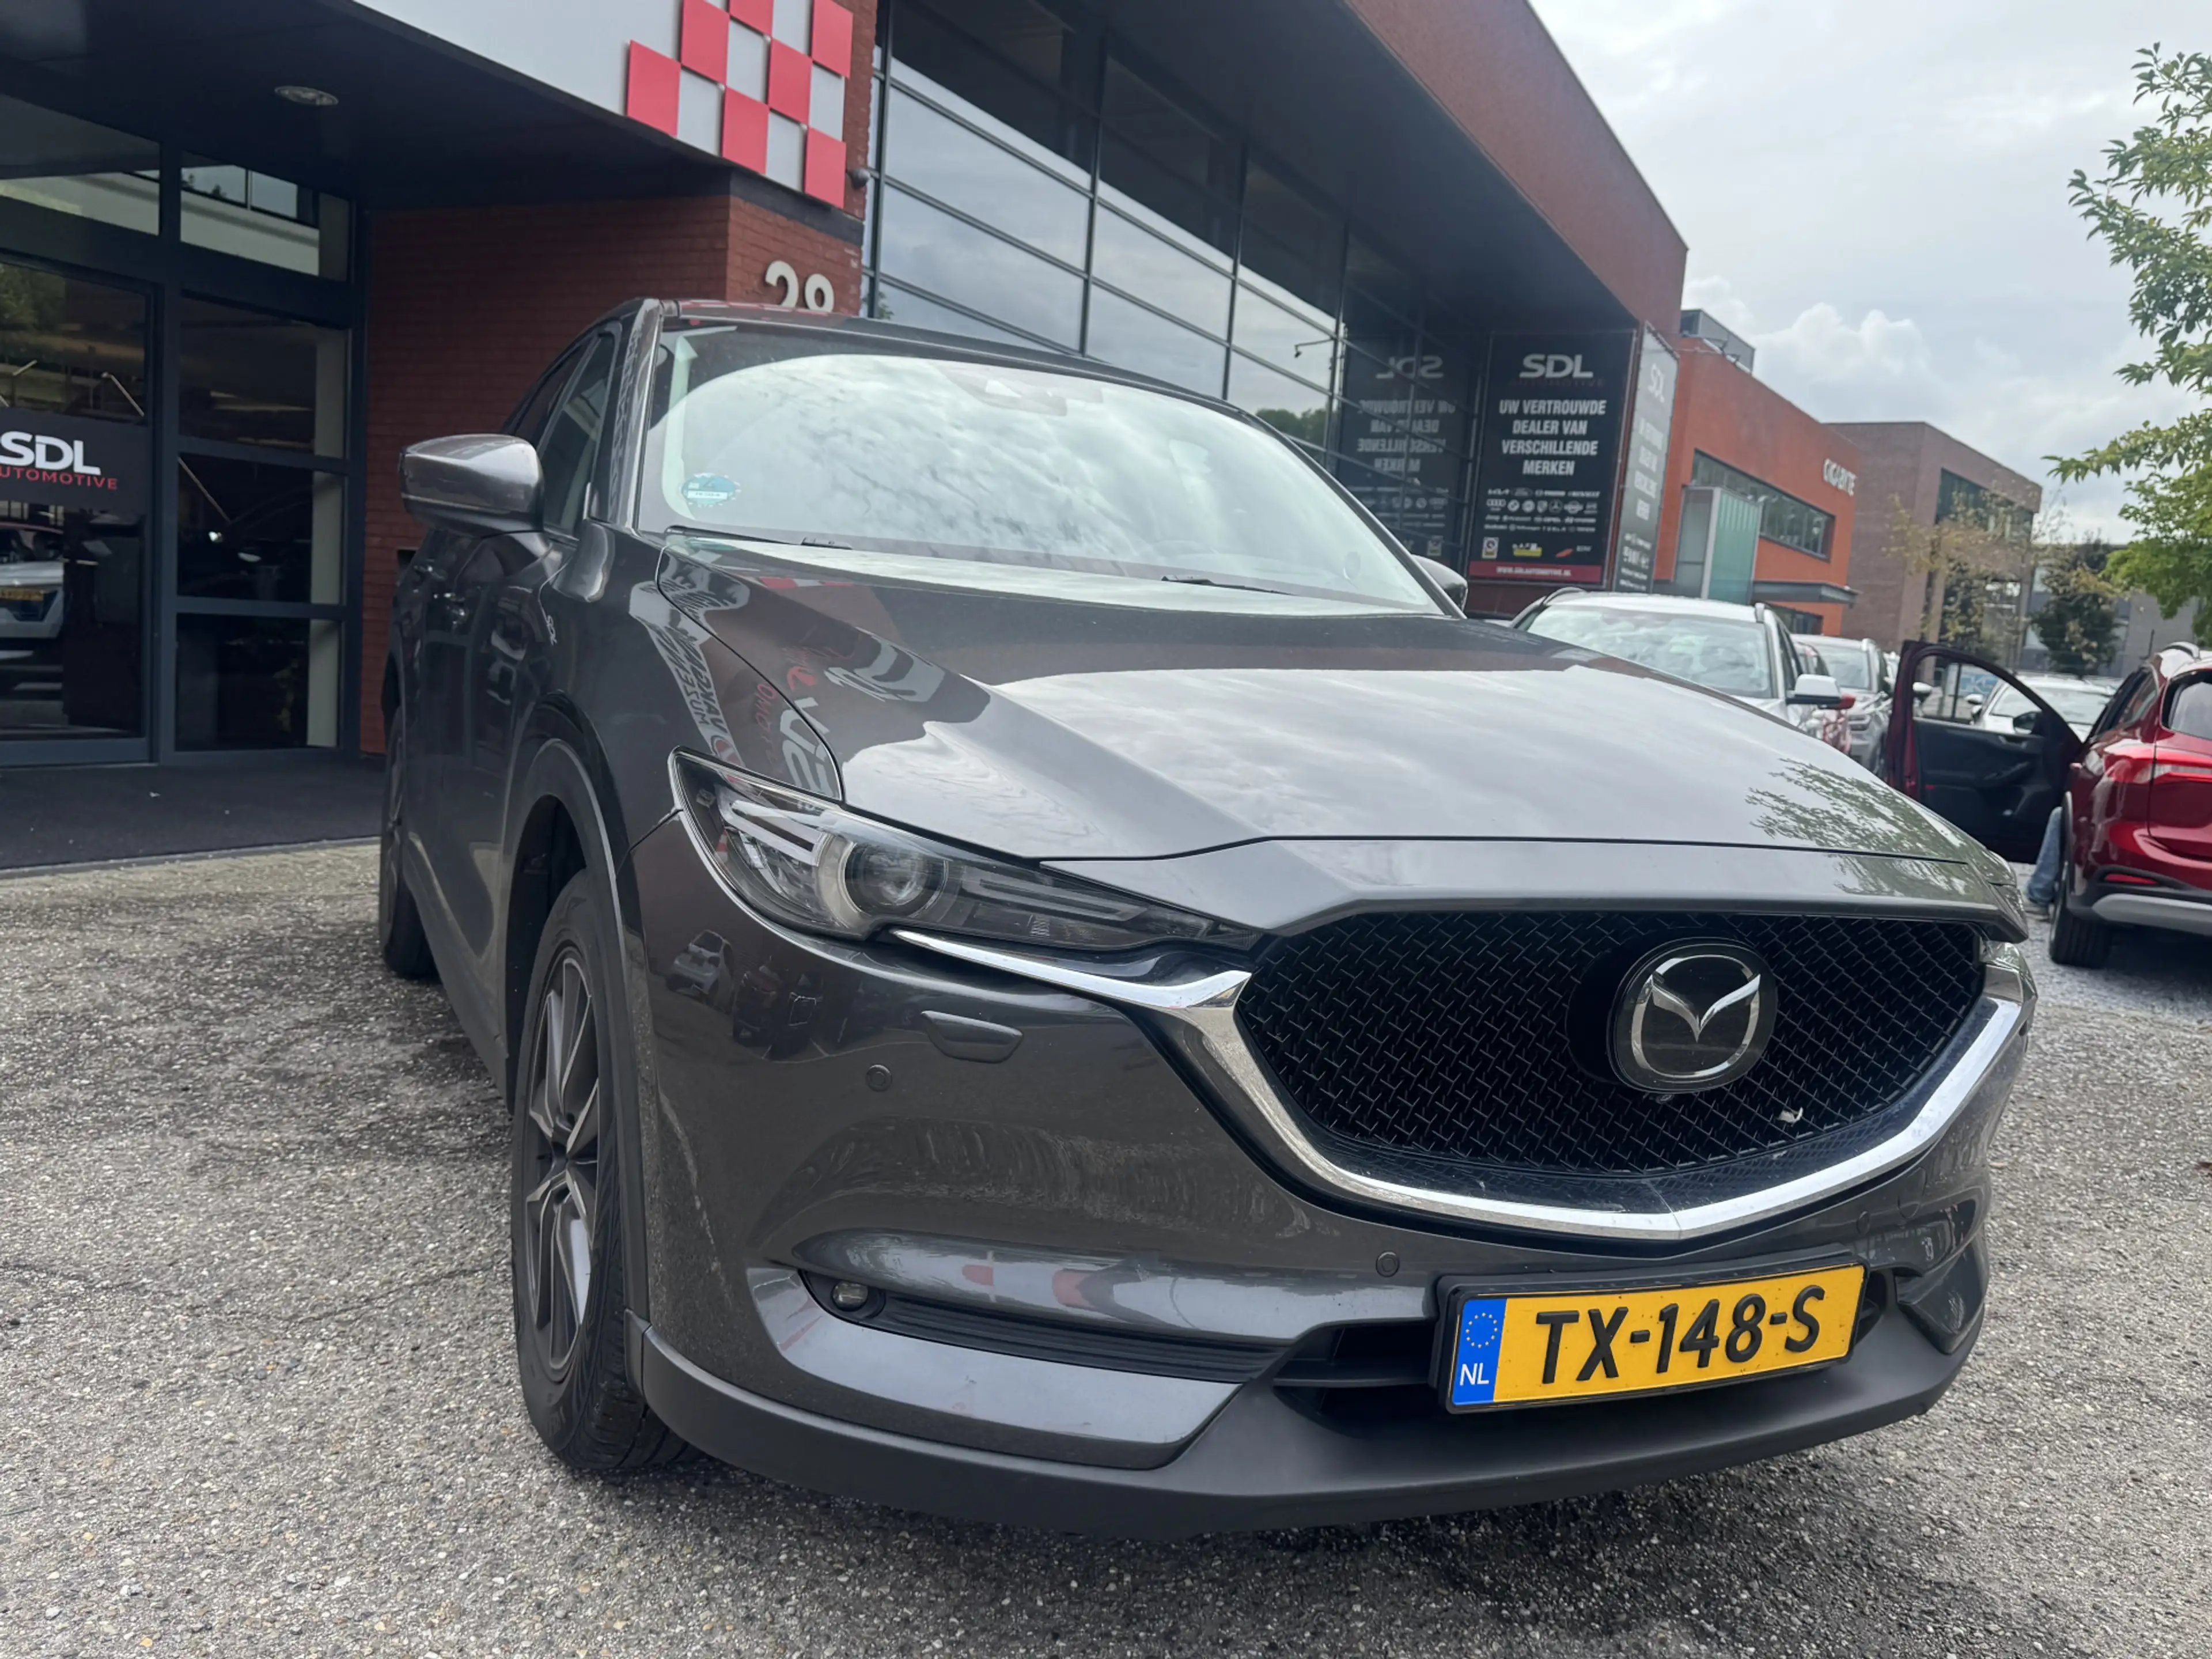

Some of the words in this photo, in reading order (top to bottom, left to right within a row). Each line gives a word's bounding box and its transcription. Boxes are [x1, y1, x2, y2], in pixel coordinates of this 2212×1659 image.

[1519, 353, 1593, 378] SDL
[1499, 400, 1520, 414] UW
[1522, 400, 1607, 415] VERTROUWDE
[1512, 419, 1560, 435] DEALER
[1562, 419, 1588, 435] VAN
[0, 431, 101, 475] SDL
[1502, 440, 1599, 456] VERSCHILLENDE
[0, 465, 118, 490] UTOMOTIVE
[1522, 460, 1575, 476] MERKEN
[1536, 1285, 1825, 1384] TX-148-S
[1460, 1363, 1490, 1385] NL
